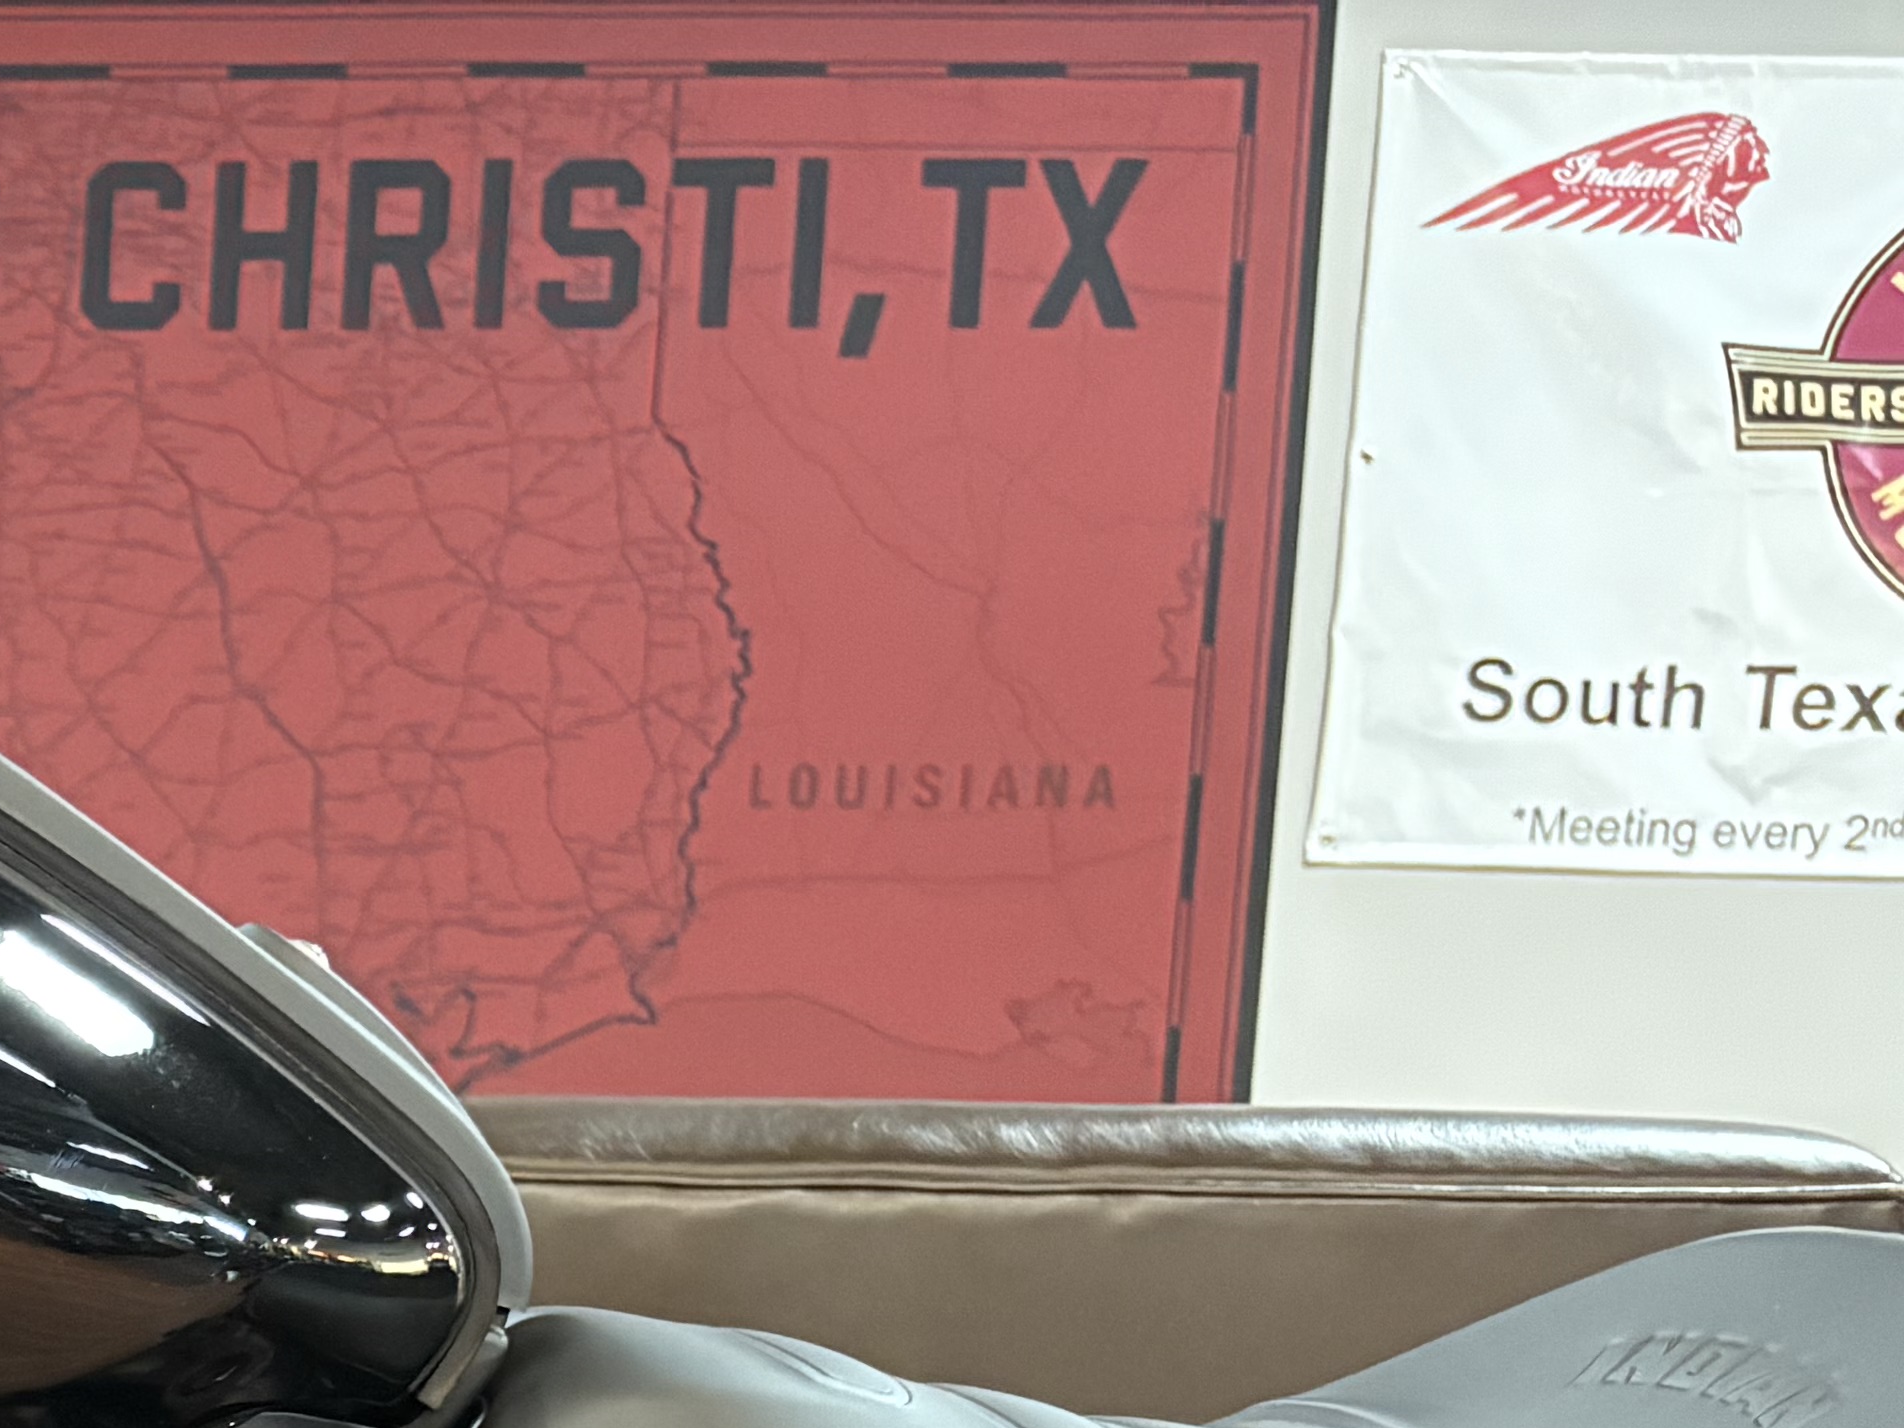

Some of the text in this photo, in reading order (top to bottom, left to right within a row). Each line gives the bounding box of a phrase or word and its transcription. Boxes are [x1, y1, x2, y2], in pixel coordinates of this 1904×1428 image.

[1553, 151, 1679, 188] Indian
[78, 156, 886, 359] CHRISTI,
[921, 157, 1150, 330] TX
[1462, 657, 1904, 734] South Tex
[748, 763, 1122, 813] LOUISIANA
[1713, 819, 1830, 861] every
